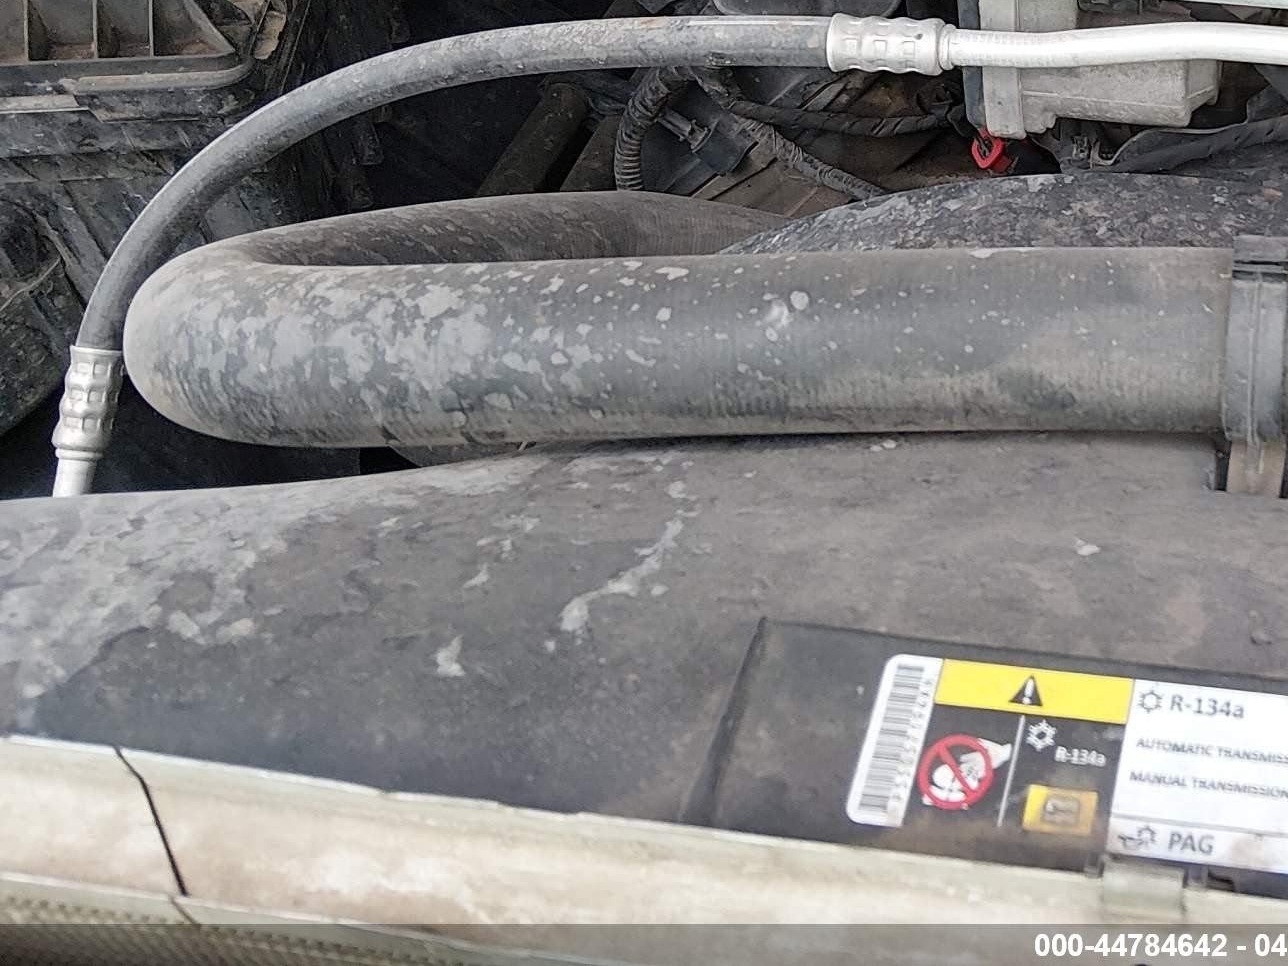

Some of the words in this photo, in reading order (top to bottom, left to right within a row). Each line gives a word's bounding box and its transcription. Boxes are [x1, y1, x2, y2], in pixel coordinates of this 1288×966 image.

[1169, 694, 1245, 719] R-134a
[1054, 745, 1107, 767] R-134a
[1136, 738, 1213, 757] AUTOMATIC
[1129, 770, 1187, 788] MANUAL
[1167, 830, 1215, 855] PAG
